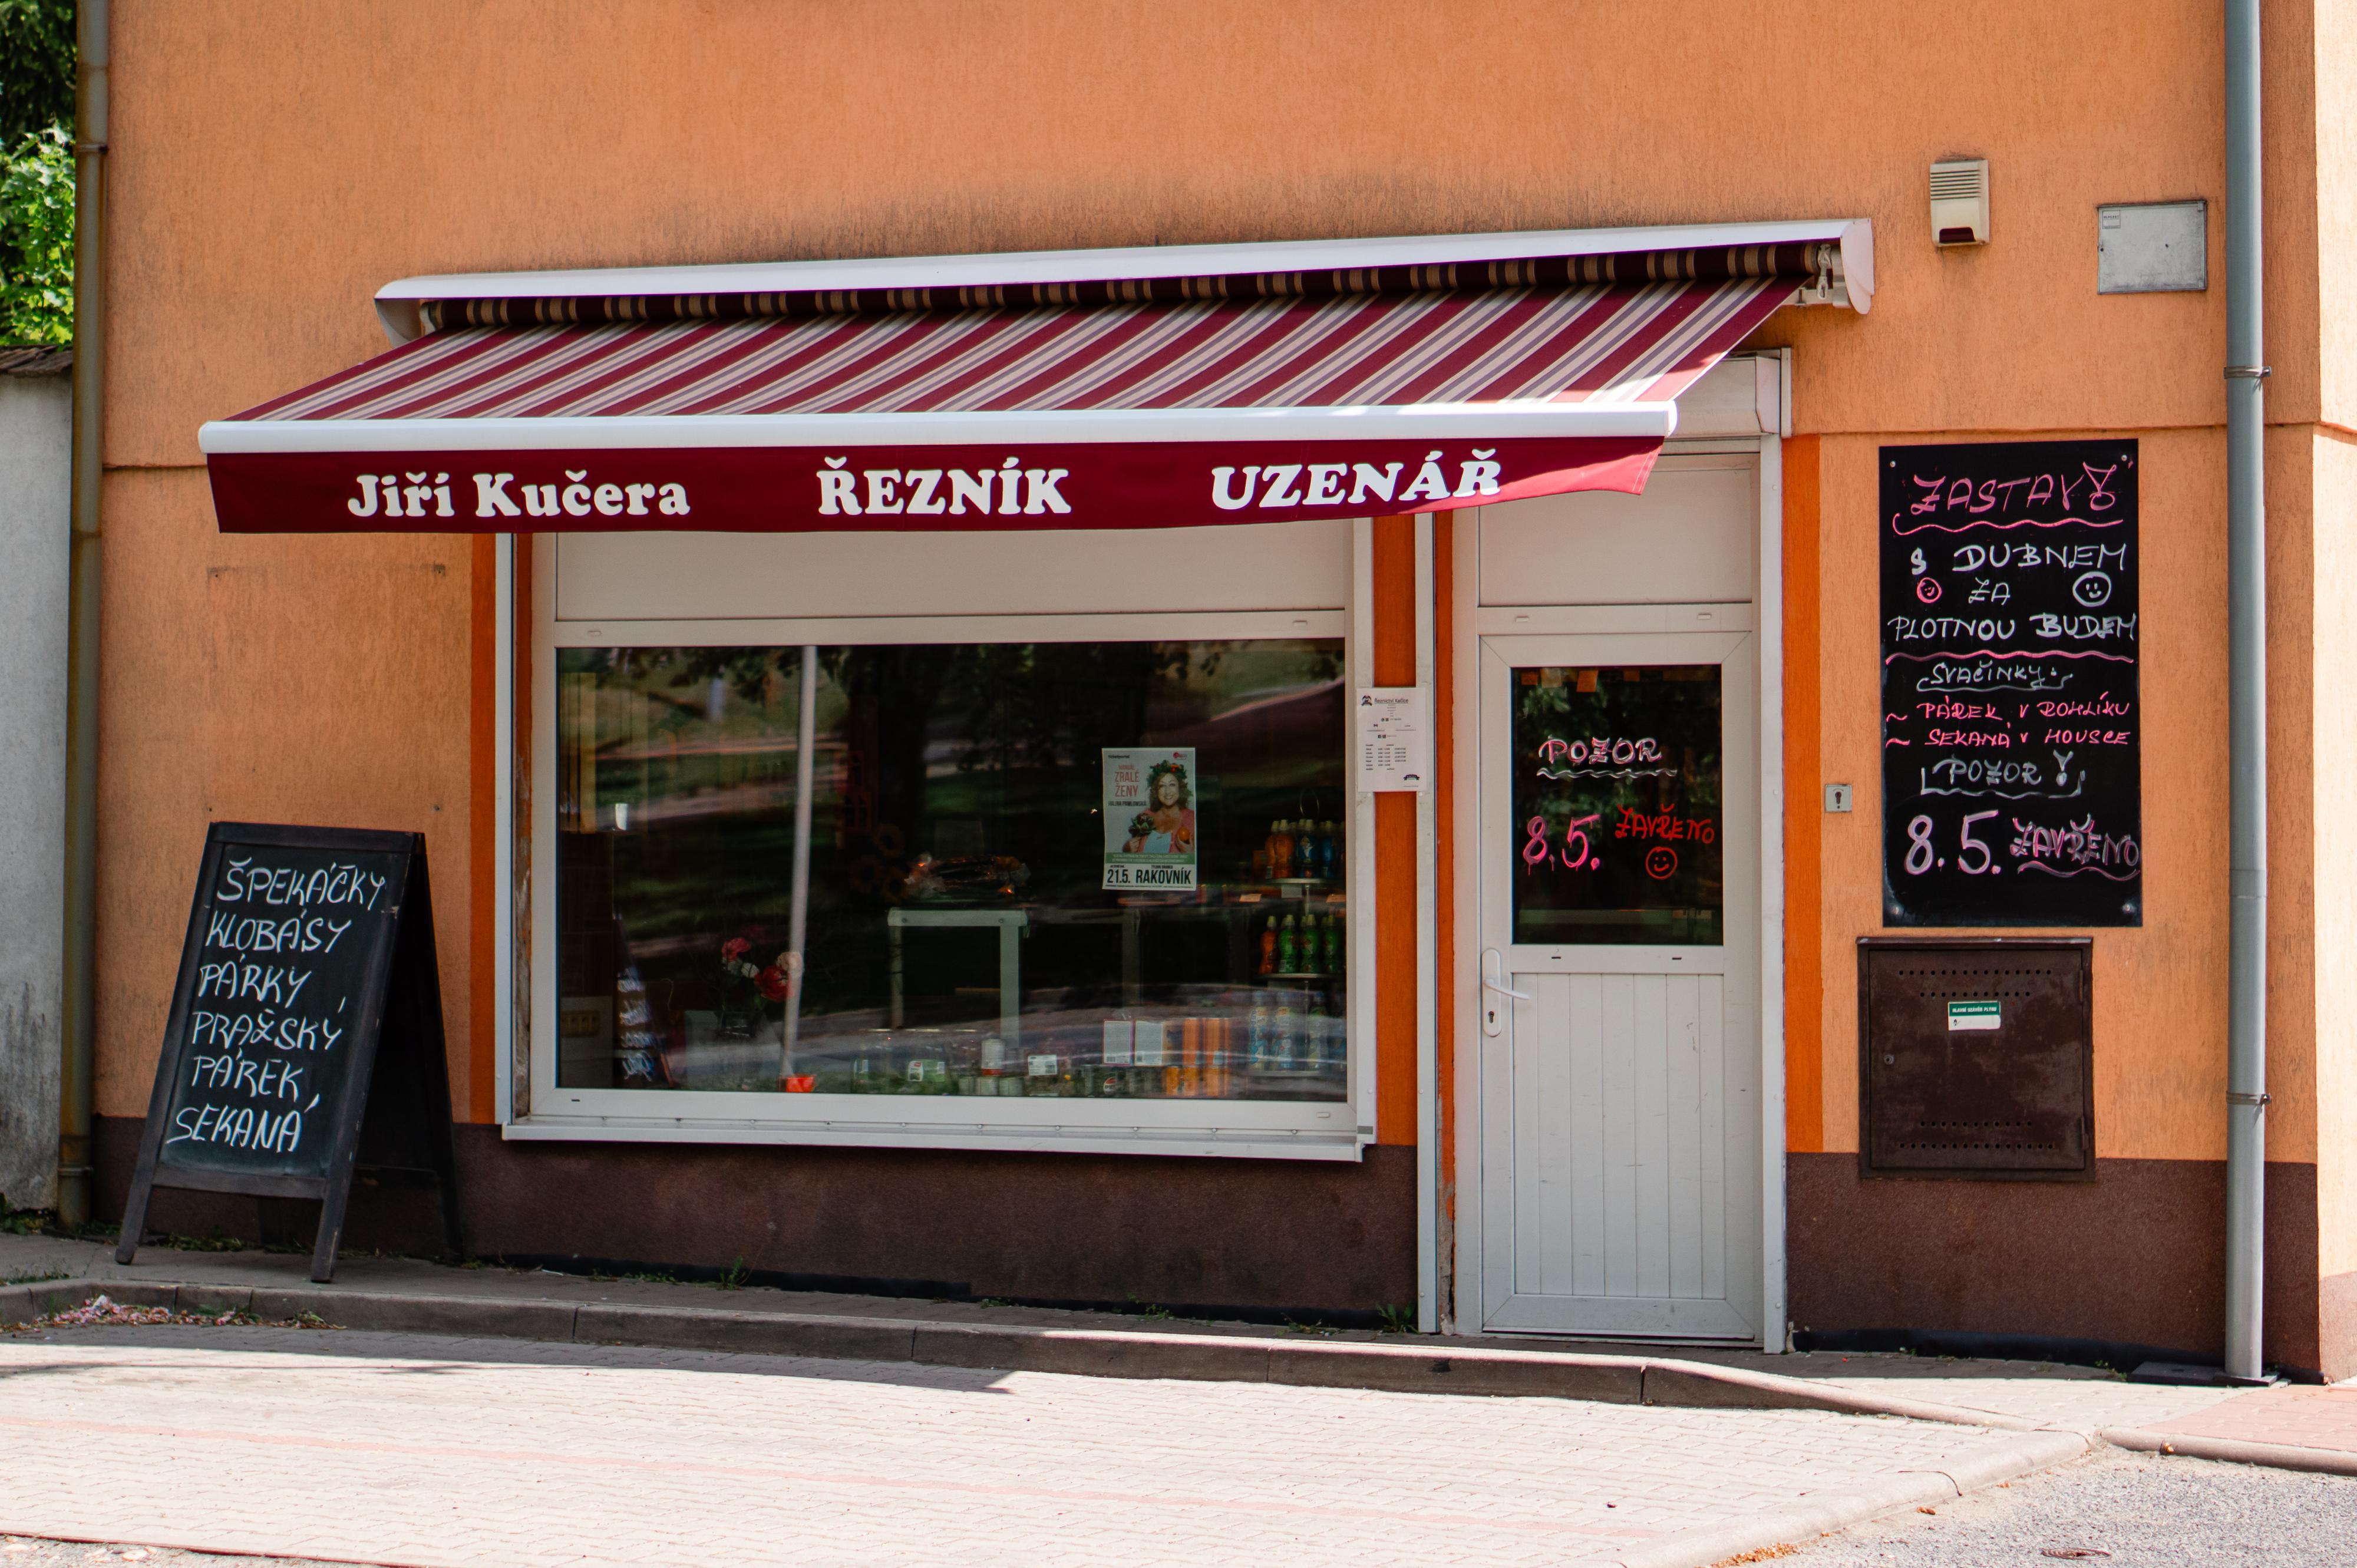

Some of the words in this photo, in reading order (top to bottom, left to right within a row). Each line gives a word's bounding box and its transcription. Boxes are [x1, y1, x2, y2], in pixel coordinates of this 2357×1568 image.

[348, 471, 455, 517] Jiří
[472, 469, 691, 517] Kučera
[816, 456, 1072, 516] ŘEZNÍK
[1211, 448, 1501, 510] UZENÁŘ
[1952, 543, 2127, 572] DUBNEM
[1887, 616, 2015, 641] PLOTNOU
[2029, 613, 2137, 642] BUDEM
[1916, 695, 2003, 721] PÁREK
[2036, 691, 2130, 717] ROHLÍKU
[1538, 735, 1663, 765] POZOR
[1924, 722, 2011, 748] SEKANÁ
[2044, 730, 2131, 745] HOUSCE
[1114, 769, 1140, 783] ZRALÉ
[1115, 783, 1139, 797] ŽENY
[1614, 803, 1715, 844] ZAVŘENO
[2009, 813, 2139, 866] ZAVŘENO
[216, 856, 386, 911] ŠPEKÁČKY
[1135, 867, 1191, 884] RAKOVNÍK
[206, 909, 352, 953] KLOBÁSY
[198, 953, 312, 1008] PÁRKY
[192, 997, 346, 1051] PRAŽSKÝ
[166, 1093, 320, 1153] SEKANÁ
